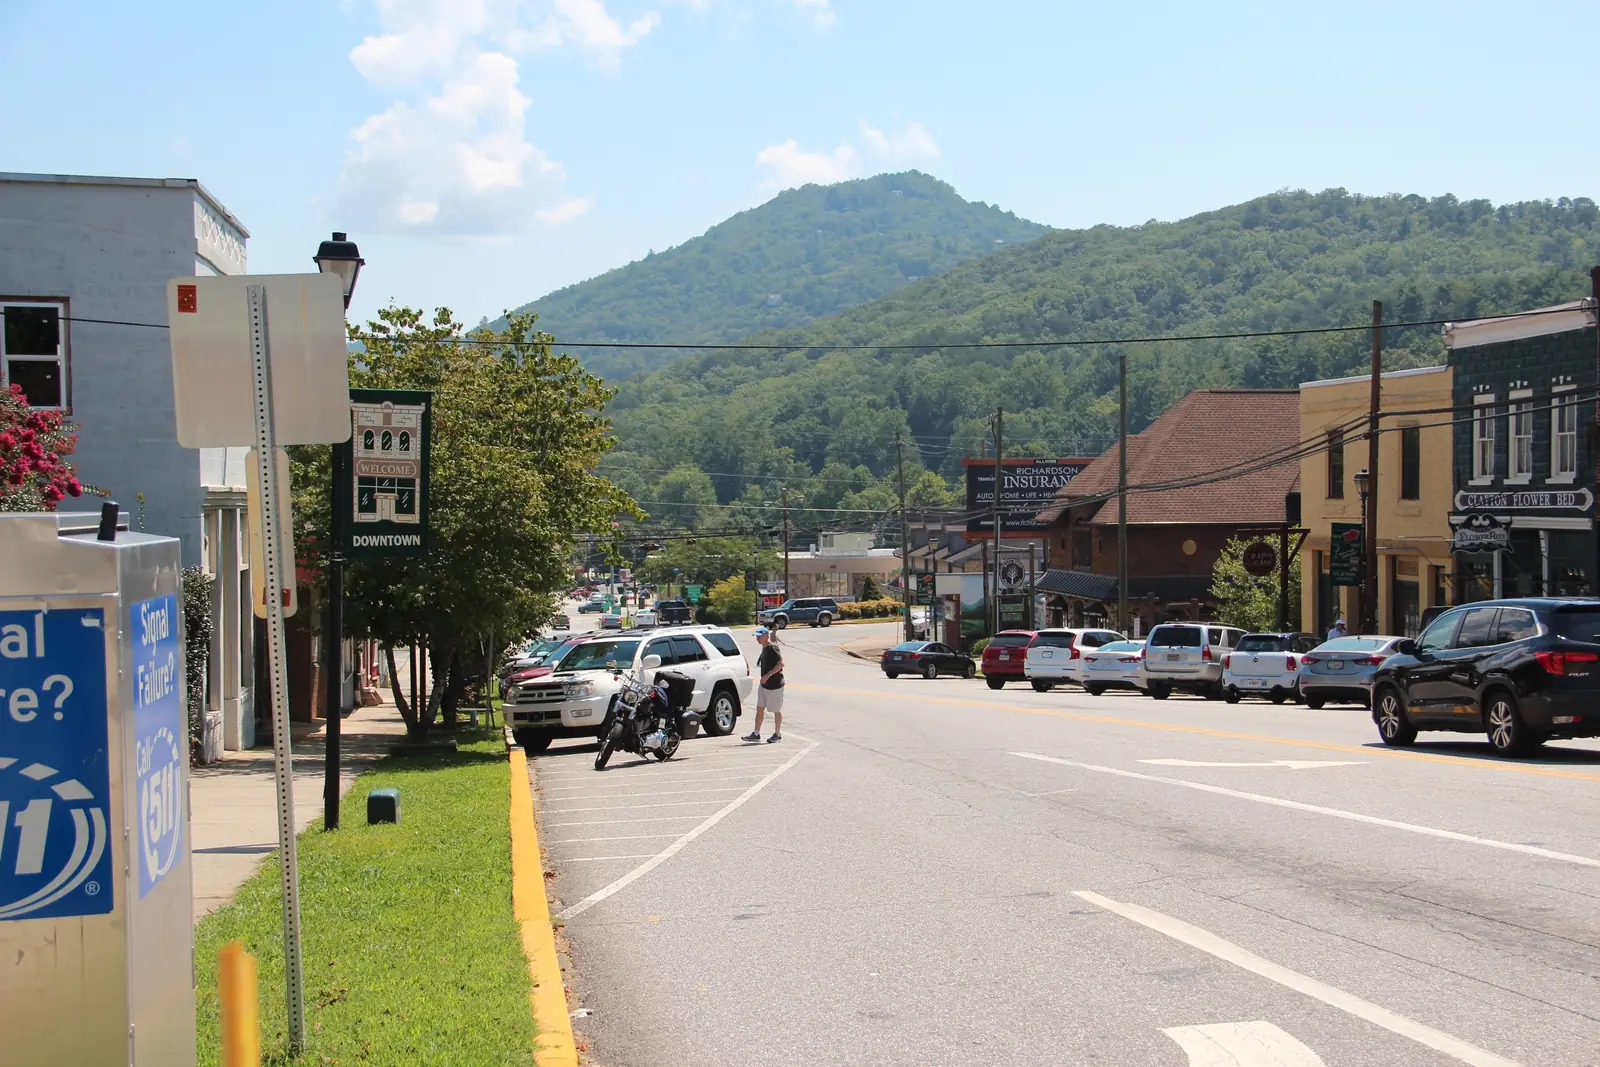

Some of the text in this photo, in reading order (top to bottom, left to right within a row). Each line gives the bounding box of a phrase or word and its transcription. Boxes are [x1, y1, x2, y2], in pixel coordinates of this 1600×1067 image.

[361, 463, 411, 475] WELCOME
[1016, 467, 1078, 475] RICHARDSON
[1468, 493, 1575, 506] CLAYTON FLOWER BED
[353, 535, 421, 547] DOWNTOWN
[141, 598, 170, 653] Signal
[138, 651, 175, 709] Failure?
[136, 736, 151, 777] Call
[149, 762, 174, 844] 511
